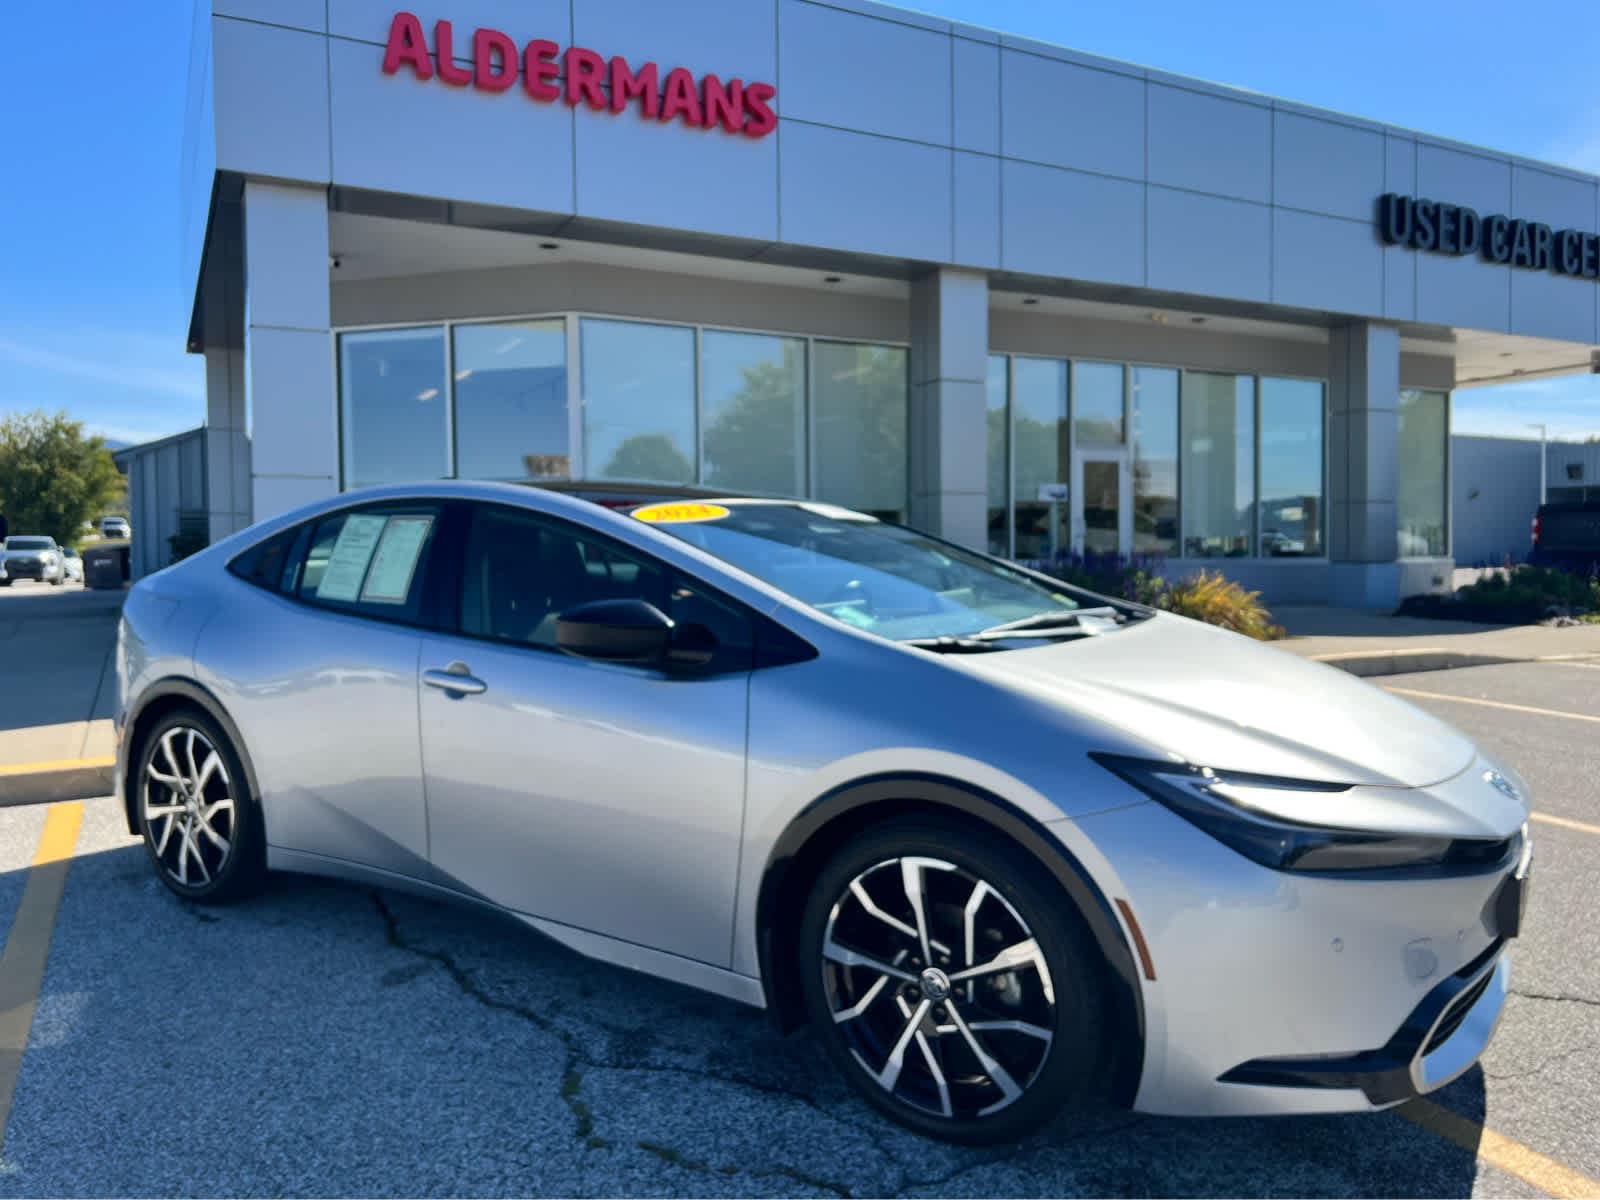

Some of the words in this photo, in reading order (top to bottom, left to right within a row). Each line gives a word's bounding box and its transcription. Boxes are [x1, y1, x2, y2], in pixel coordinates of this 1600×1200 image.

[382, 12, 777, 137] ALDERMANS
[1376, 193, 1480, 256] USED
[1481, 214, 1552, 270] CAR
[1553, 228, 1600, 281] CE
